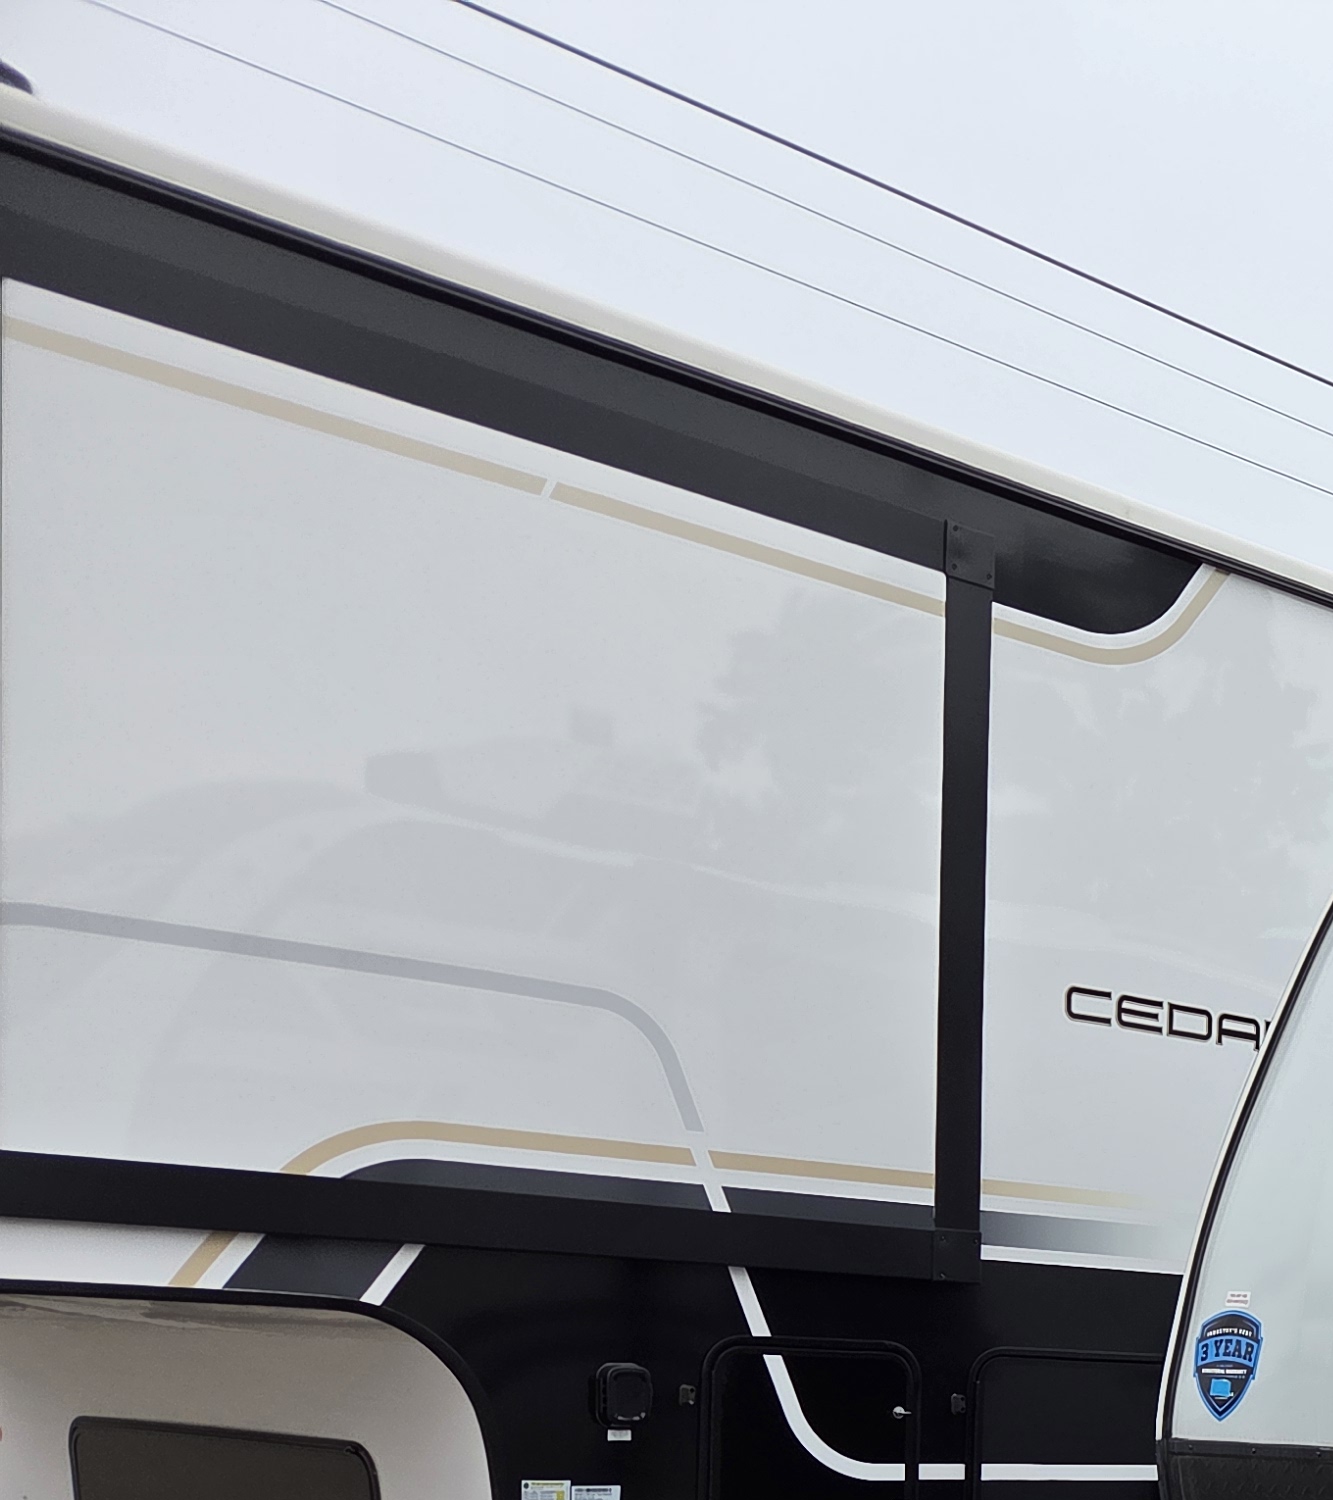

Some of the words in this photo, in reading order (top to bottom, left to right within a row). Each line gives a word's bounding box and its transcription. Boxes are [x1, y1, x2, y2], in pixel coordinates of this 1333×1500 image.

[1064, 985, 1271, 1052] CEDA
[1200, 1343, 1209, 1361] 3
[1213, 1339, 1254, 1362] YEAR
